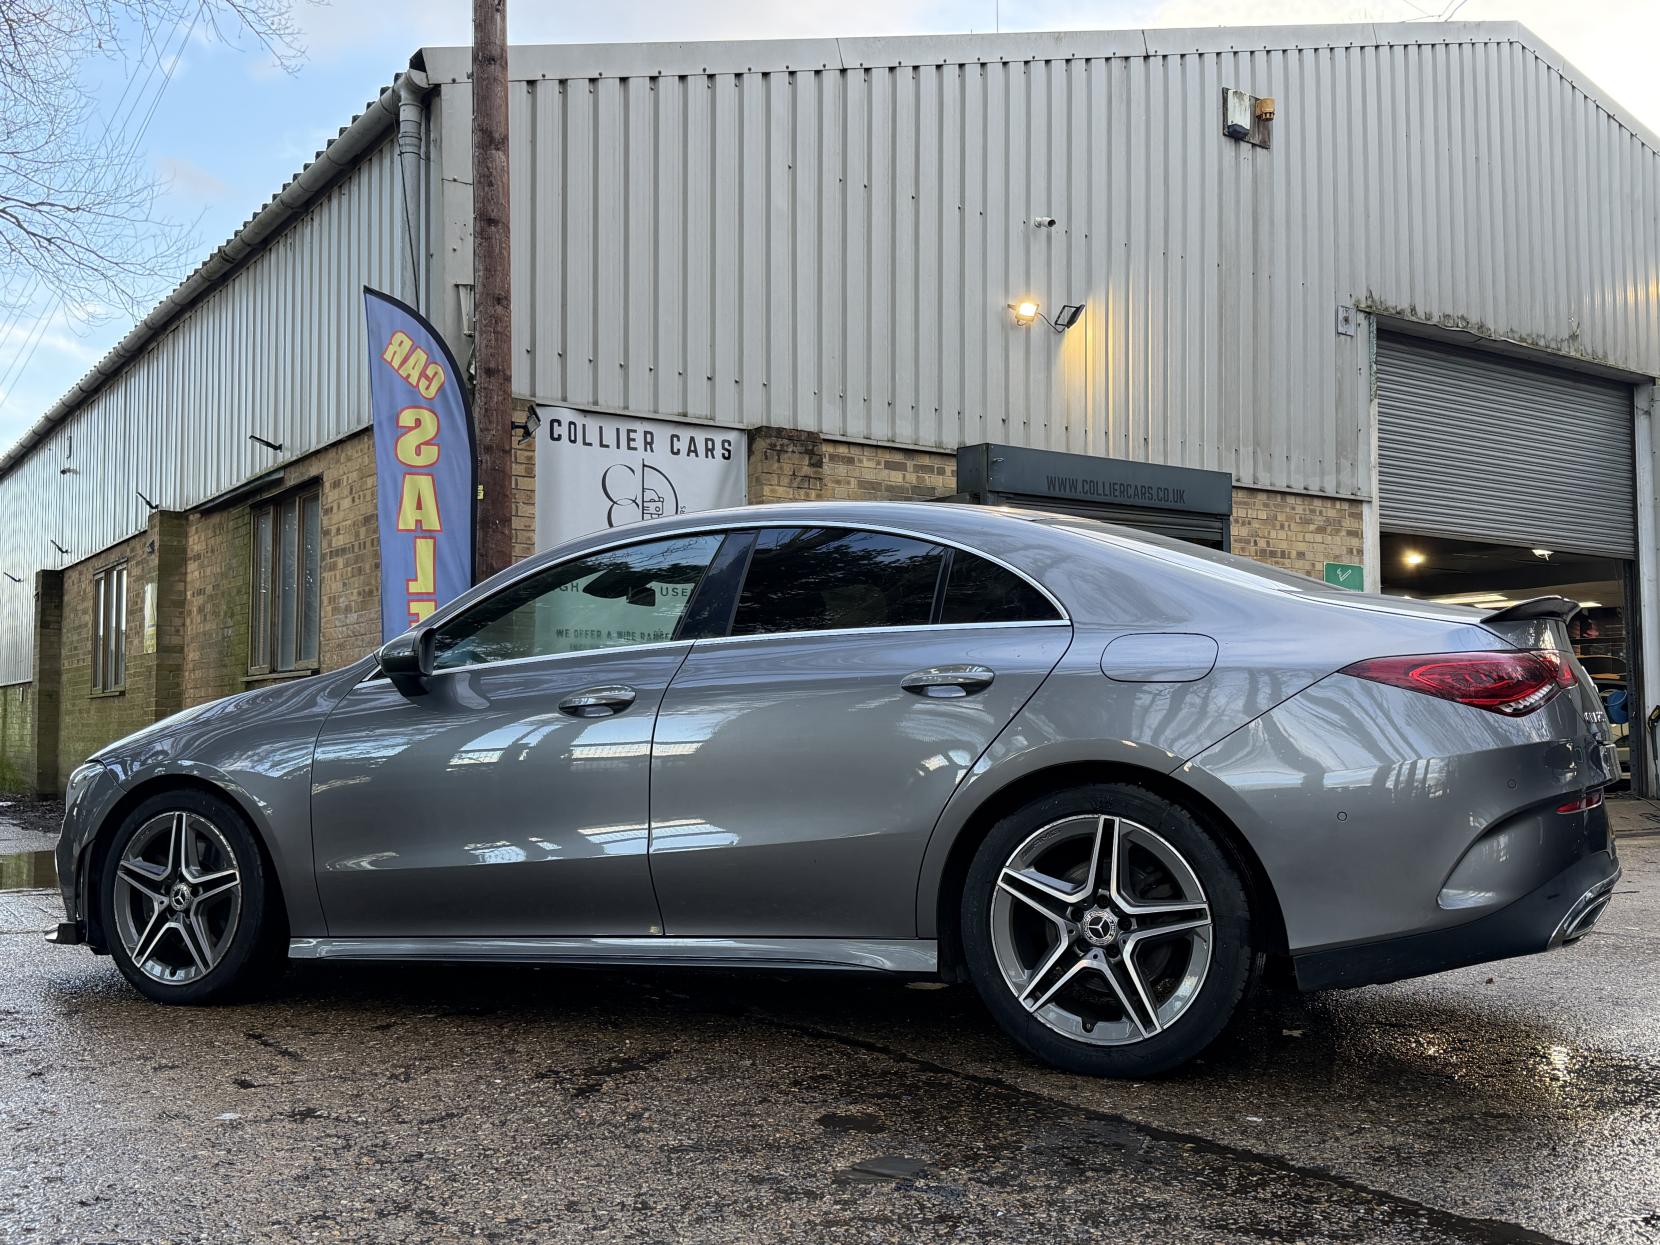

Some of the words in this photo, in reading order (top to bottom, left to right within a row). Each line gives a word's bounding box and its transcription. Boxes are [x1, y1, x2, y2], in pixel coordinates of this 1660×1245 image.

[549, 418, 655, 453] COLLIER
[669, 433, 733, 461] CARS
[1046, 474, 1187, 505] WWW.COLLIERCARS.CO.UK
[660, 584, 692, 597] USE
[555, 628, 571, 639] WE
[573, 629, 602, 640] OFFER
